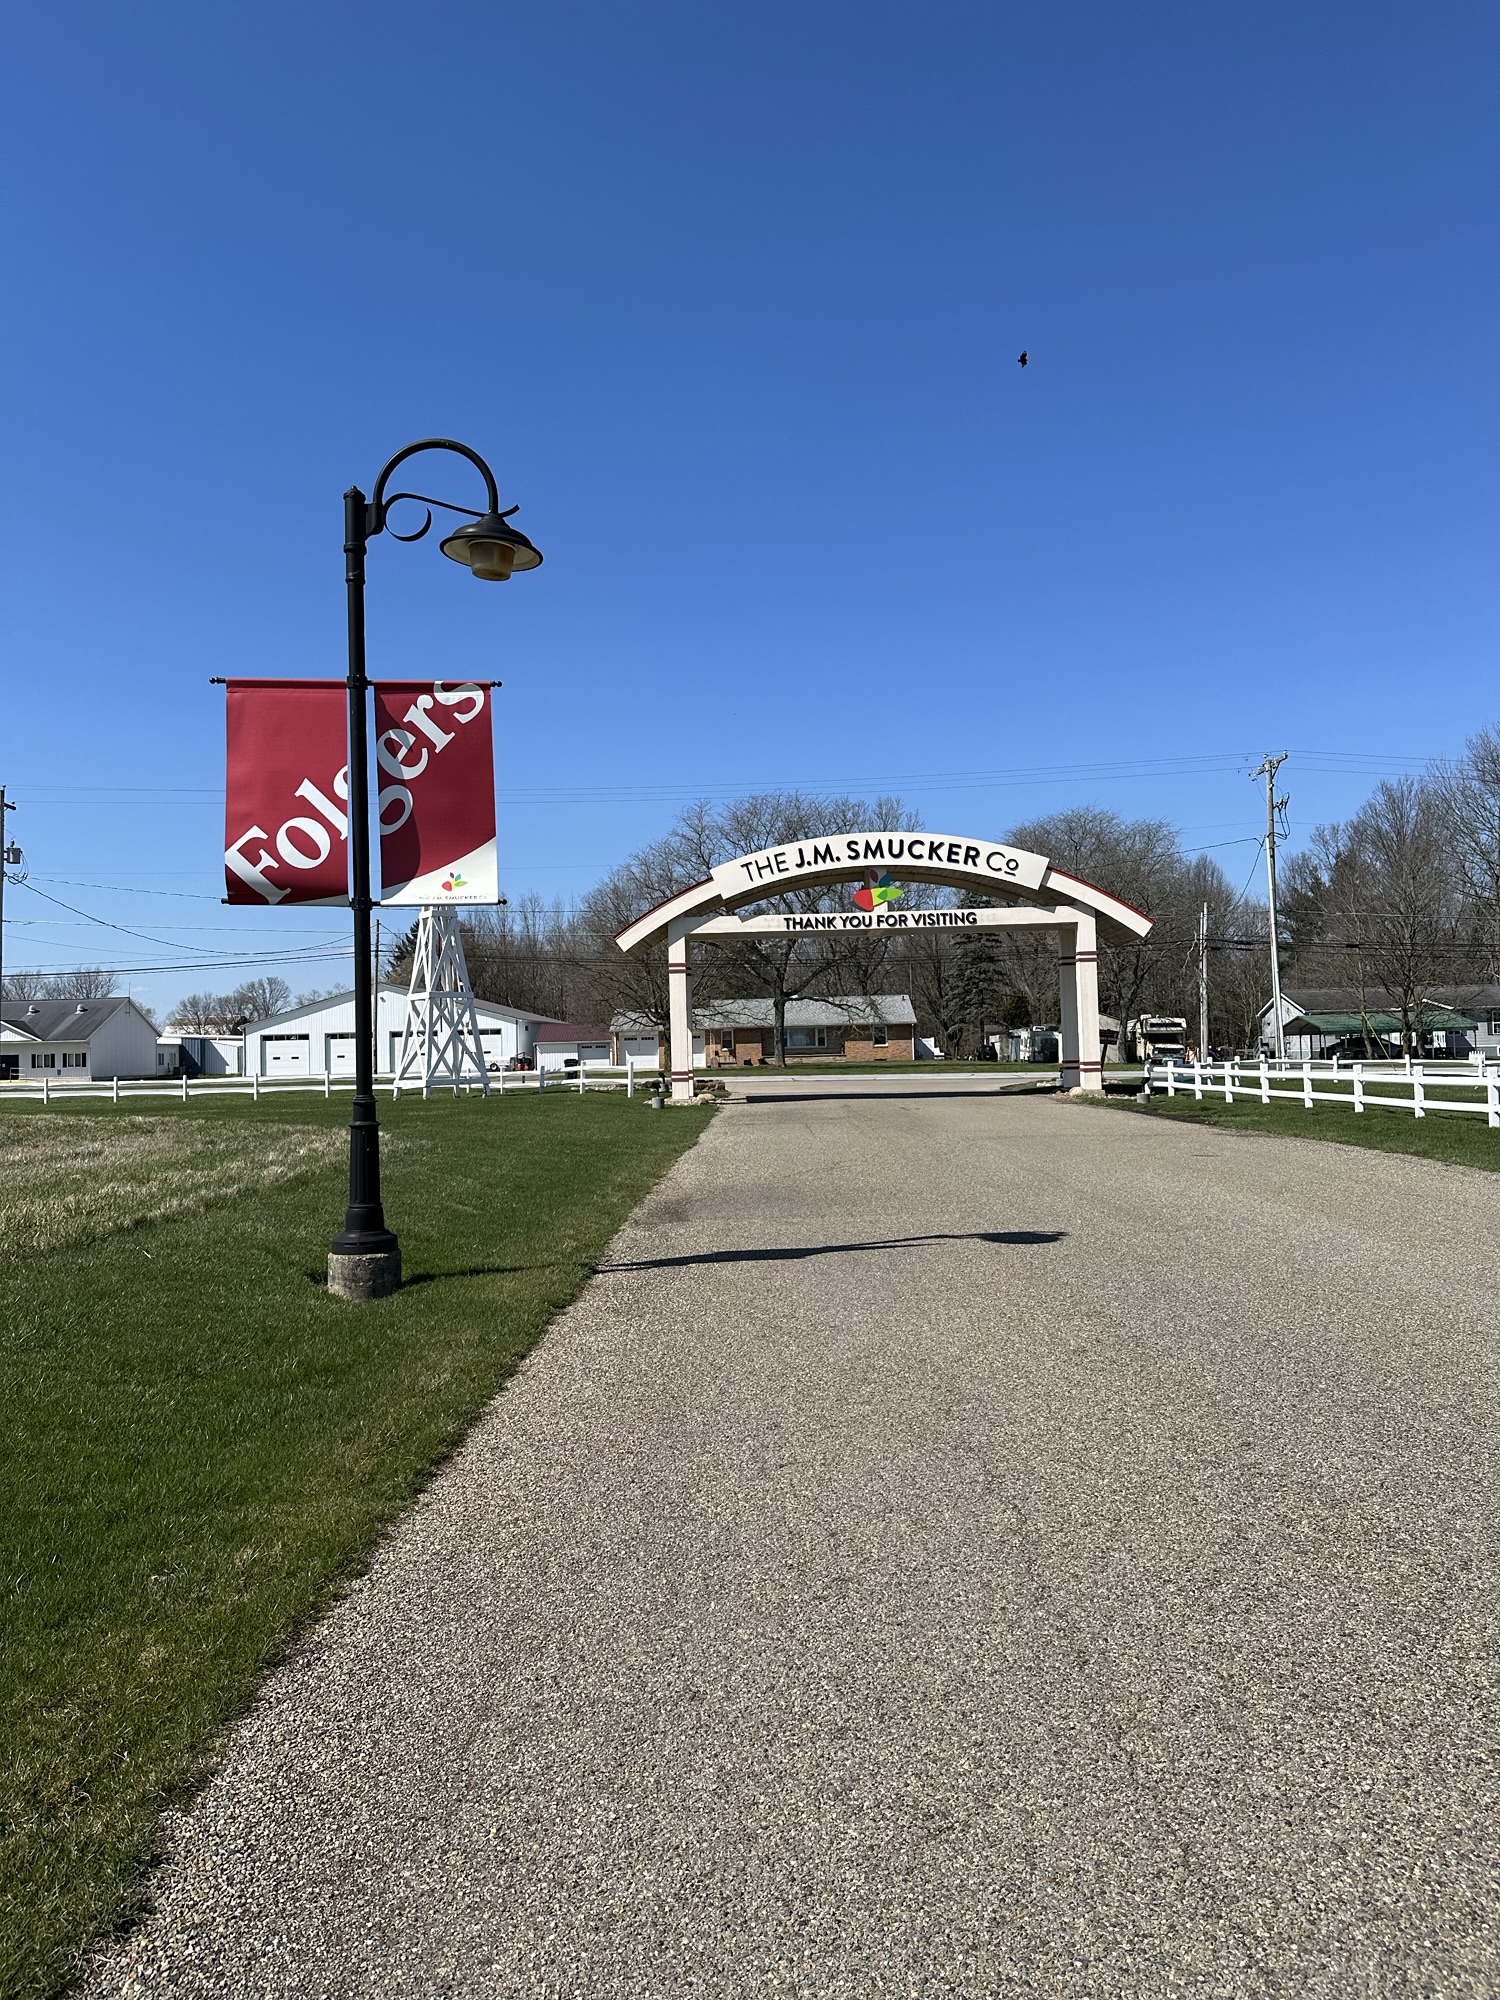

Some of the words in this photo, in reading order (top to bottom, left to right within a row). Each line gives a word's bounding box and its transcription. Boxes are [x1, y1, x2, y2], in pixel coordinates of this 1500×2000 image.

[741, 852, 790, 882] THE
[795, 843, 841, 869] J.M.
[846, 838, 980, 867] SMUCKER
[986, 851, 1019, 876] Co
[784, 916, 838, 930] THANK
[839, 915, 873, 929] YOU
[876, 914, 908, 928] FOR
[911, 911, 977, 927] VISITING
